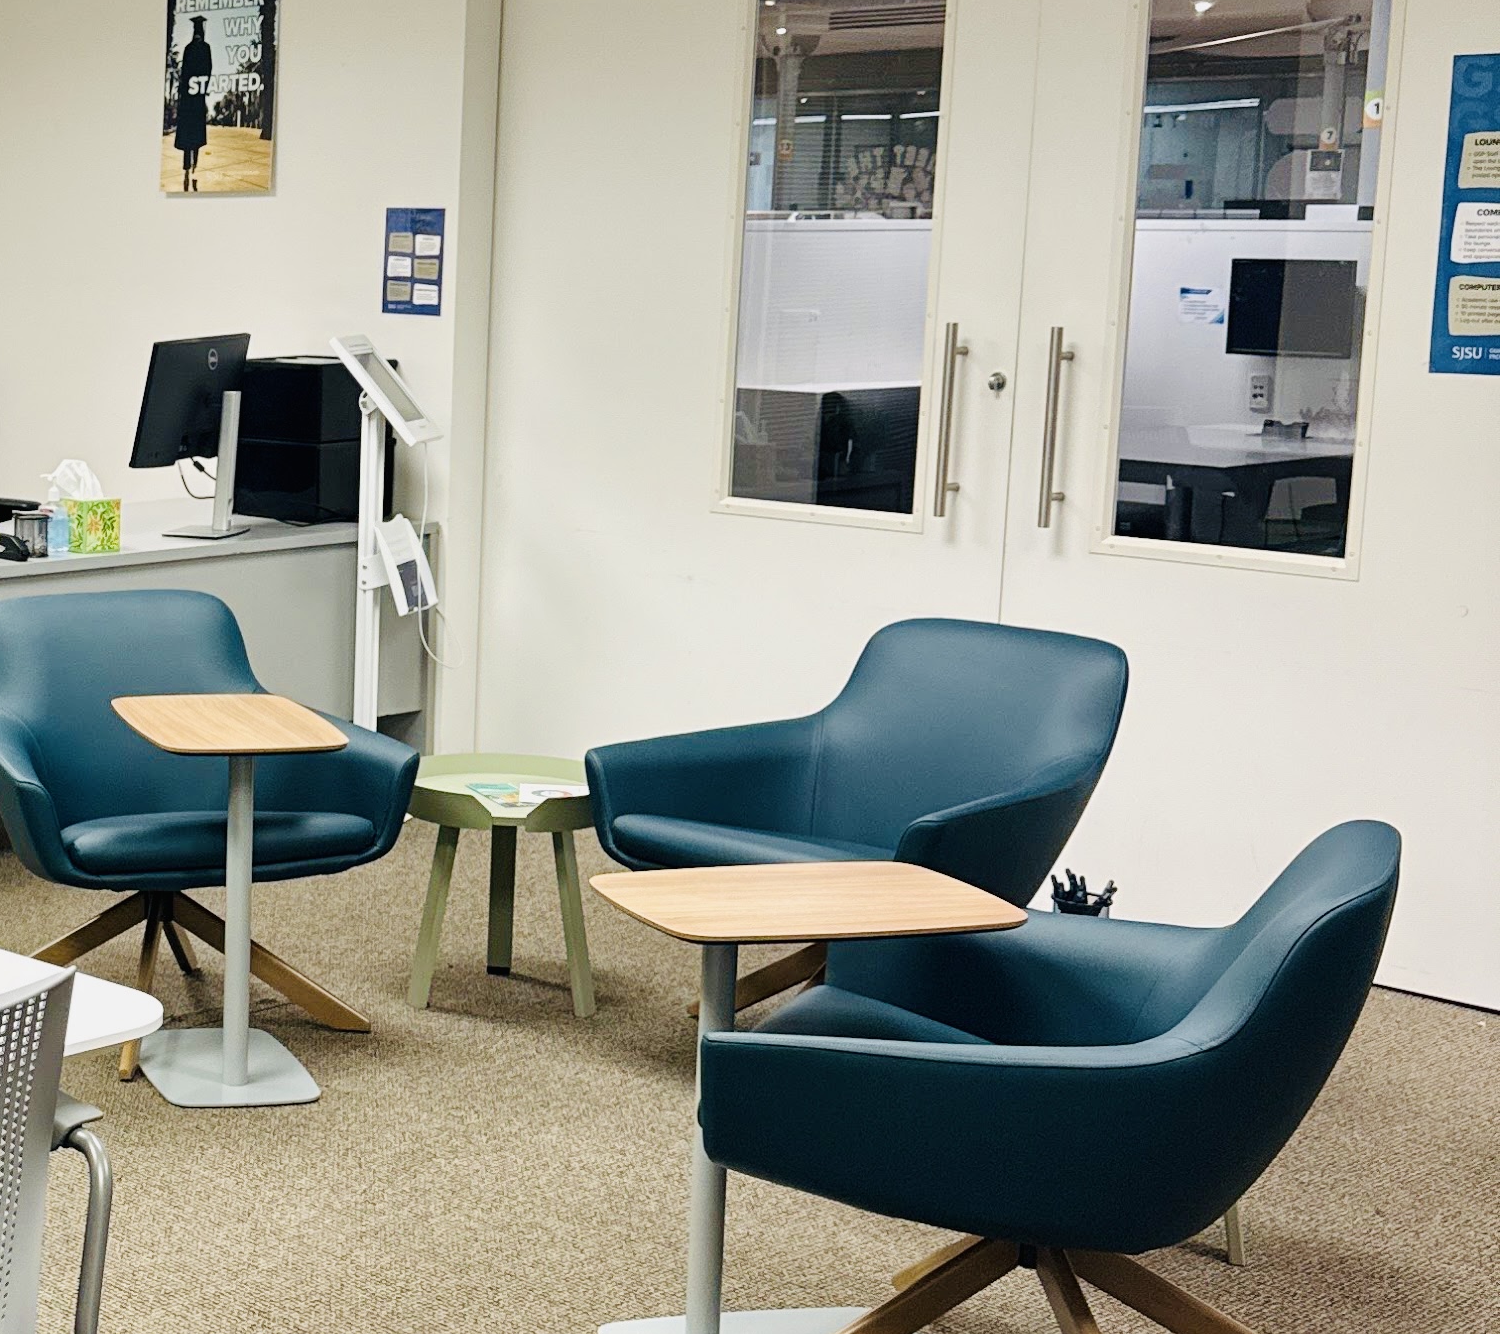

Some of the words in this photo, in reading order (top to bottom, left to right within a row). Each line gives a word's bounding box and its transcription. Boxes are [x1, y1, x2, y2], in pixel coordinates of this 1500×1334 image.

[223, 15, 264, 37] WHY
[225, 44, 262, 65] YOU
[187, 72, 265, 96] STARTED.
[1452, 345, 1482, 360] SJSU
